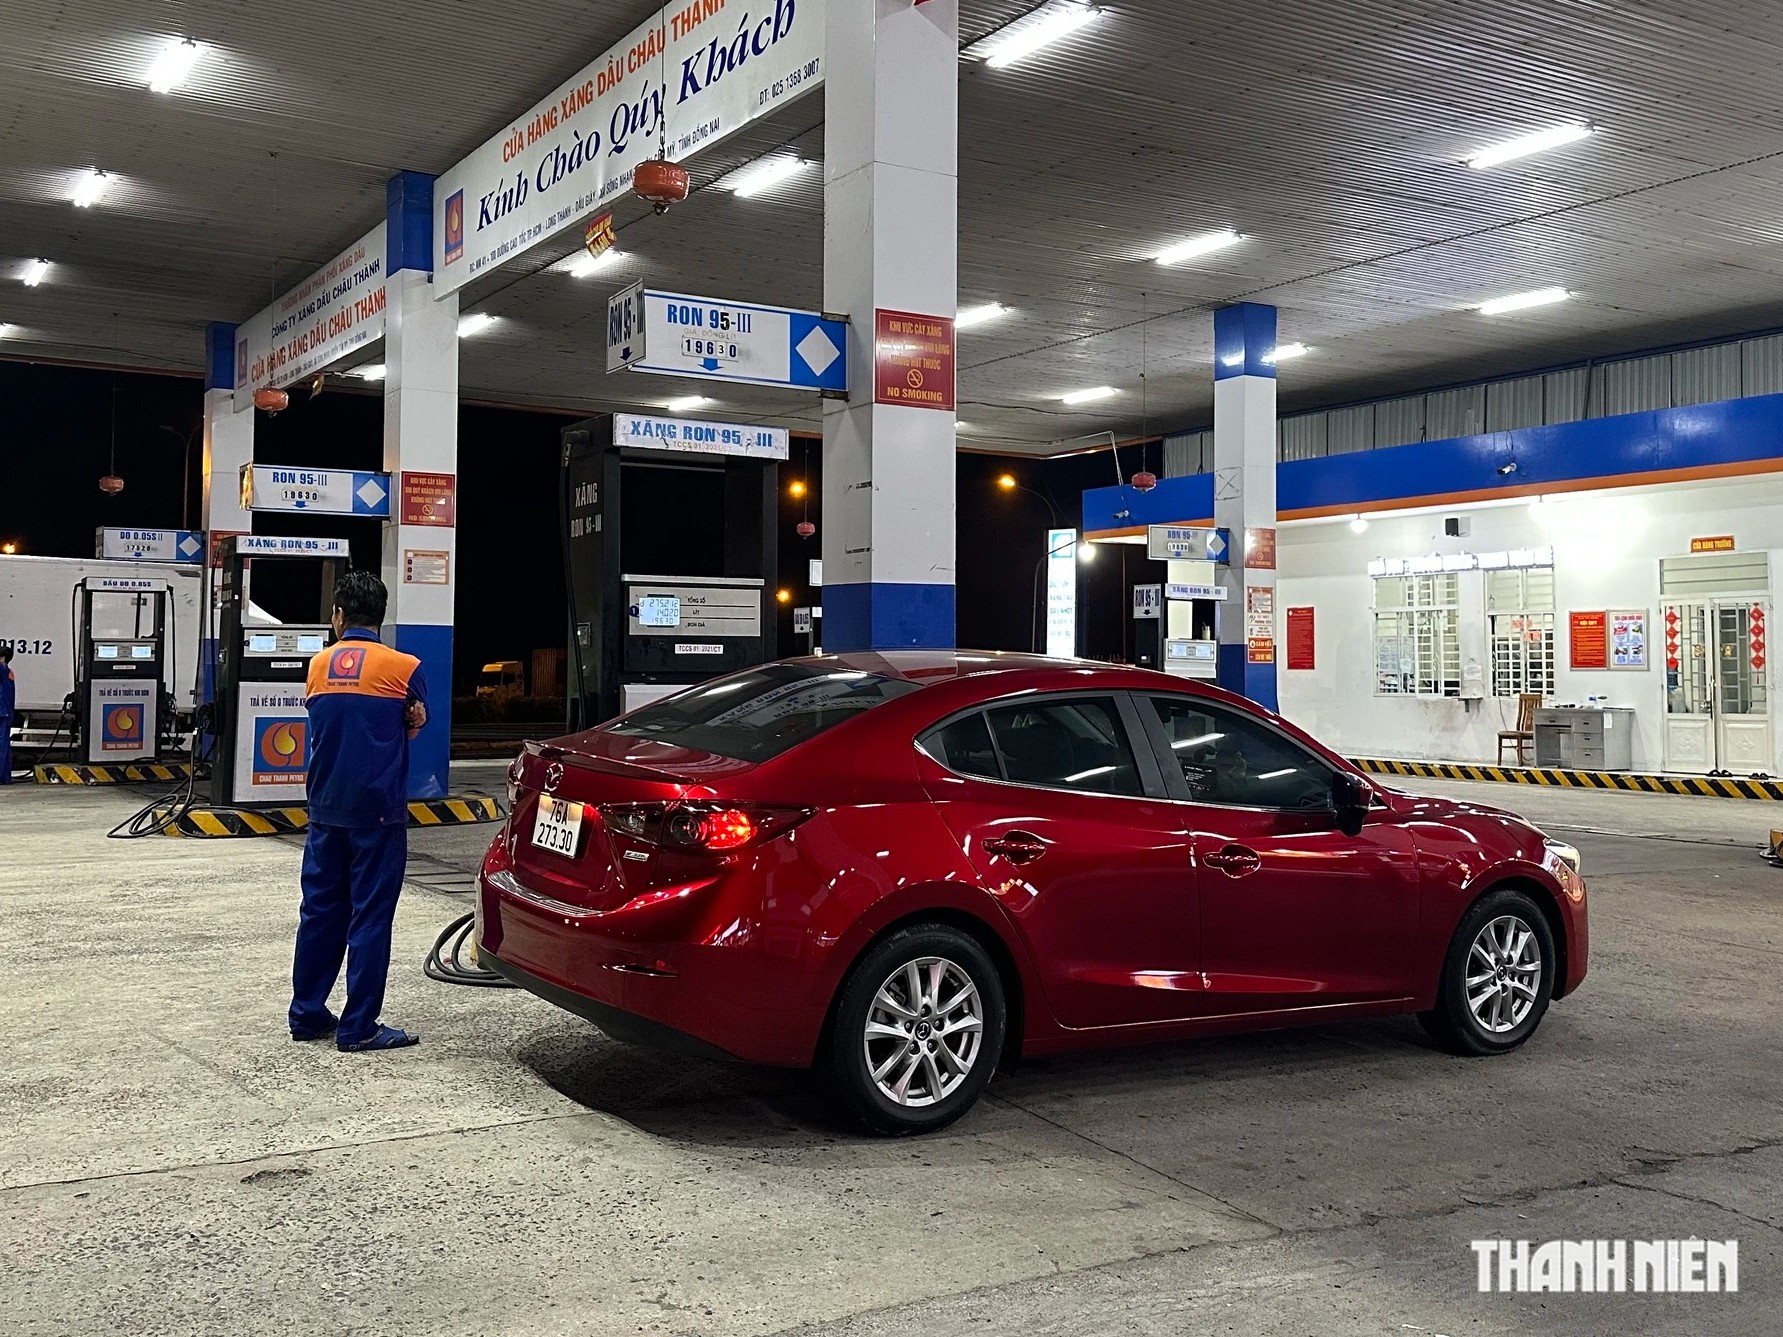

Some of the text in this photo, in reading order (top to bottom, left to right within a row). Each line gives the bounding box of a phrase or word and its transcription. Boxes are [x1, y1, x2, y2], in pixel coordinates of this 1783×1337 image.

[772, 79, 784, 99] 025
[803, 57, 820, 80] 3007
[503, 127, 524, 163] CỬA
[527, 105, 558, 146] HÀNG
[561, 80, 594, 123] XĂNG
[597, 55, 624, 97] DẦU
[627, 25, 666, 73] CHÂU
[476, 168, 528, 232] Kính
[535, 129, 600, 193] Chào
[676, 0, 796, 105] Khách
[692, 123, 708, 144] ĐỒNG
[709, 117, 720, 134] NAI
[546, 214, 556, 229] LONG
[272, 258, 380, 338] CÔNG TY XĂNG DẦU CHÂU THÀNH
[667, 303, 703, 327] RON
[251, 354, 265, 383] CỬA
[288, 336, 308, 364] XĂNG
[310, 318, 327, 350] DẦU
[329, 305, 352, 339] CHÂU
[354, 285, 387, 323] THÀNH
[685, 338, 737, 358] 19630
[887, 386, 943, 402] NO SMOKING
[630, 419, 677, 438] XĂNG
[682, 425, 716, 442] RON
[721, 429, 741, 445] 95
[756, 432, 772, 447] III
[272, 471, 296, 484] RON
[575, 481, 598, 508] XĂNG
[247, 537, 277, 549] XĂNG
[280, 539, 302, 549] RON
[305, 540, 318, 549] 95
[1167, 529, 1181, 540] RON
[550, 800, 569, 825] 76A
[537, 822, 573, 852] 273.30
